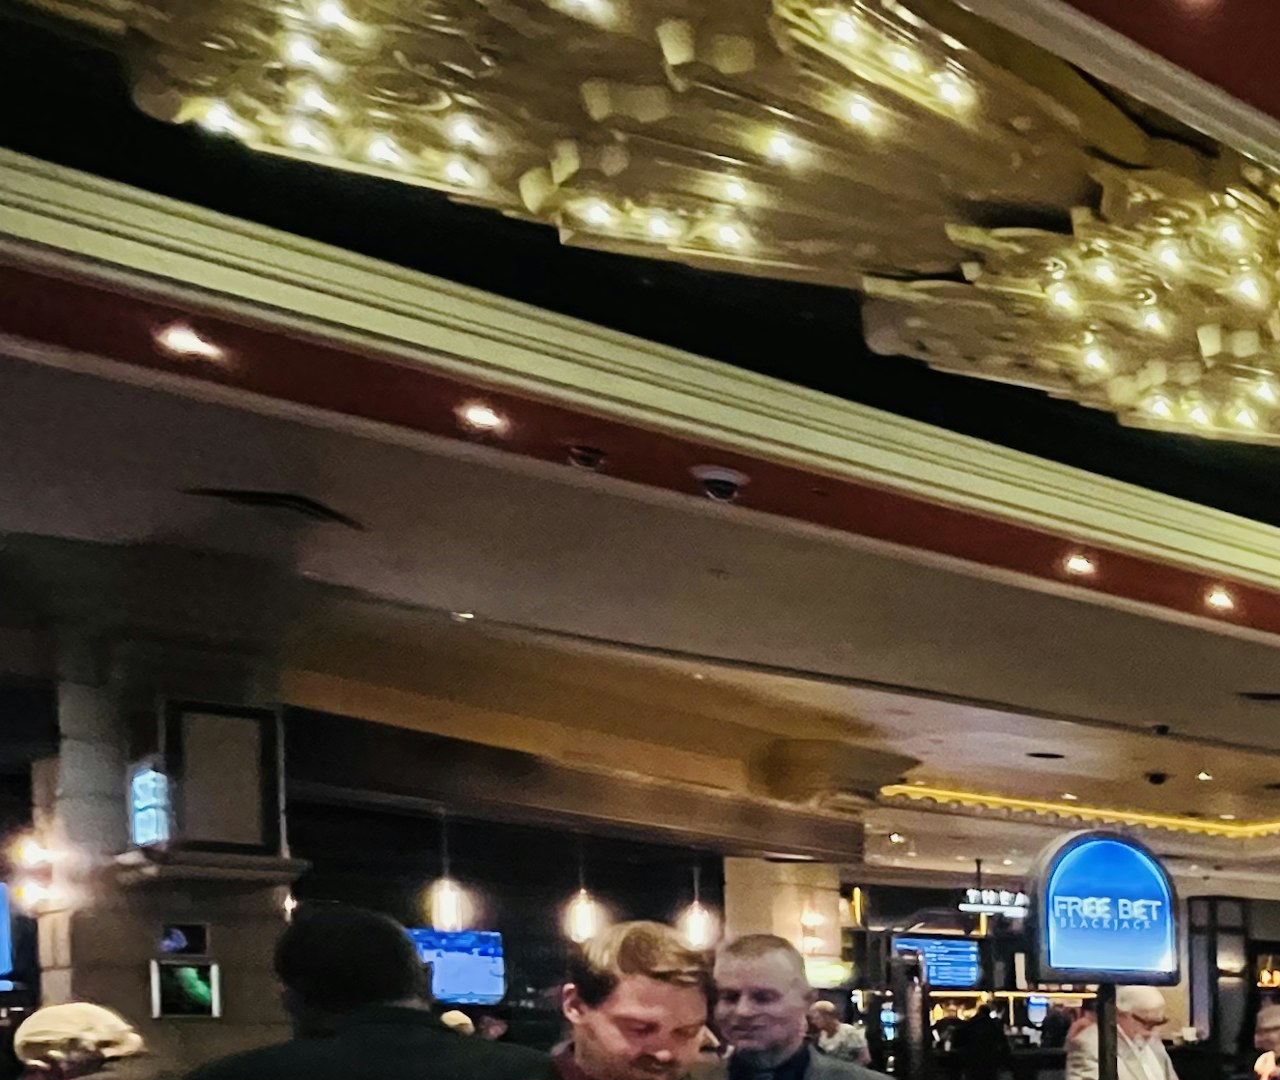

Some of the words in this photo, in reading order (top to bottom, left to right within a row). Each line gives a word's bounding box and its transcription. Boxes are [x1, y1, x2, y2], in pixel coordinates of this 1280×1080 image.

[1054, 896, 1111, 919] FREE
[1118, 898, 1162, 921] BET
[1060, 917, 1151, 931] BLACKJACK
